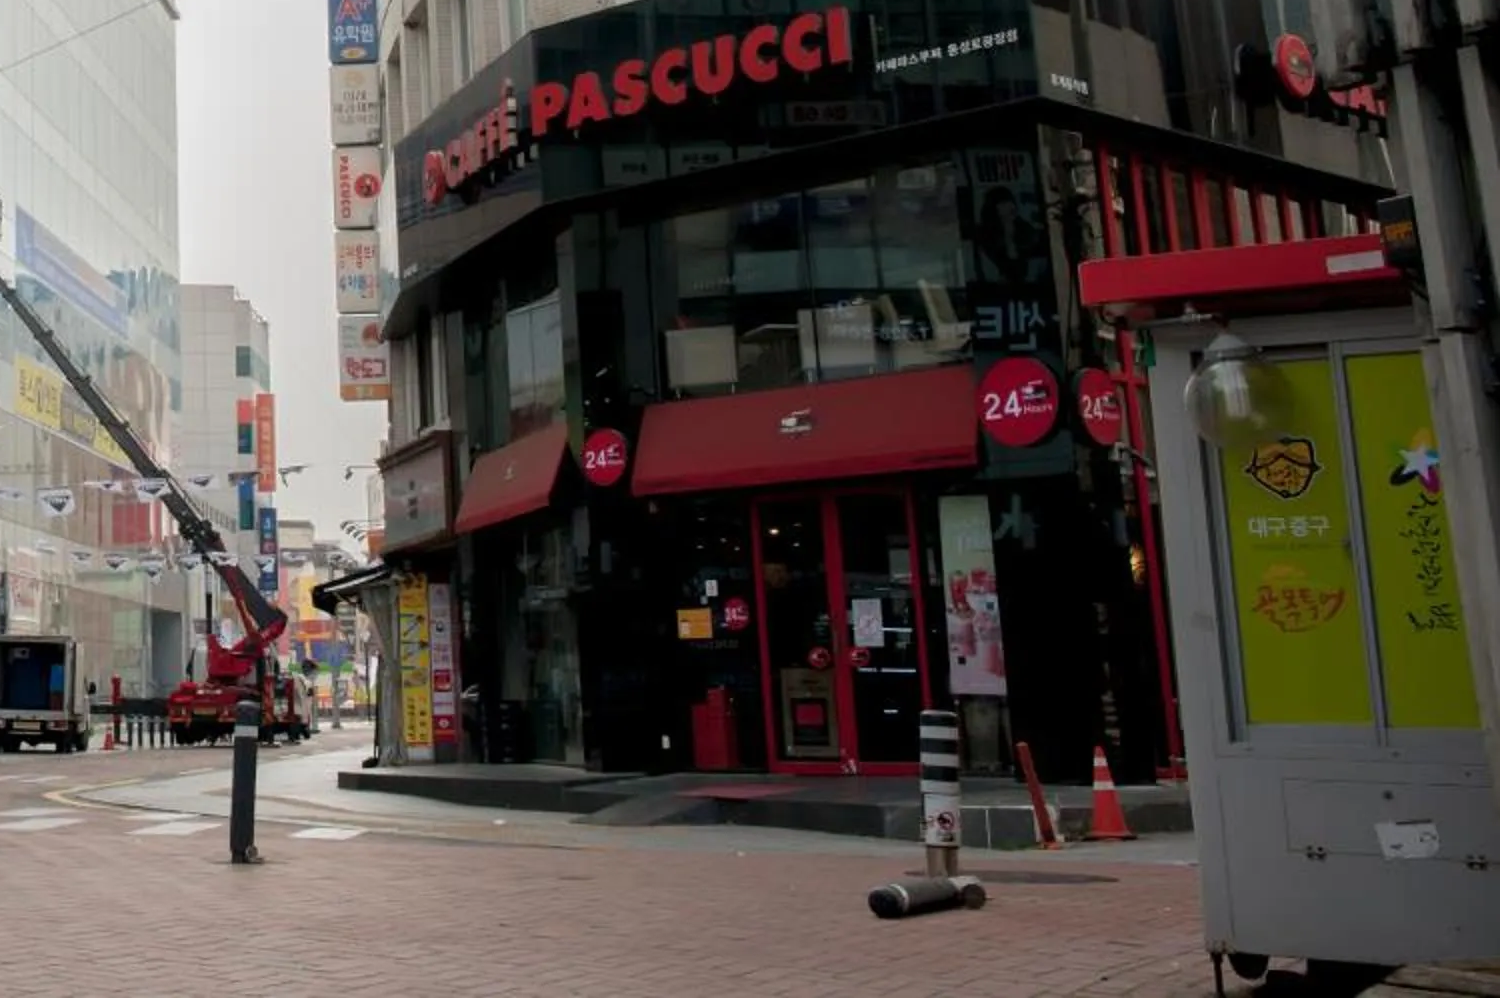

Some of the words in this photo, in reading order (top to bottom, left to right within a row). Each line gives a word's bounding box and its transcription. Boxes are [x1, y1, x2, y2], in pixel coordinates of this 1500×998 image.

[332, 24, 375, 44] 유학원
[531, 5, 854, 138] PASCUCCI
[983, 390, 1023, 421] 24
[1082, 395, 1104, 420] 24
[586, 448, 607, 471] 24
[1248, 515, 1332, 540] 대구중구
